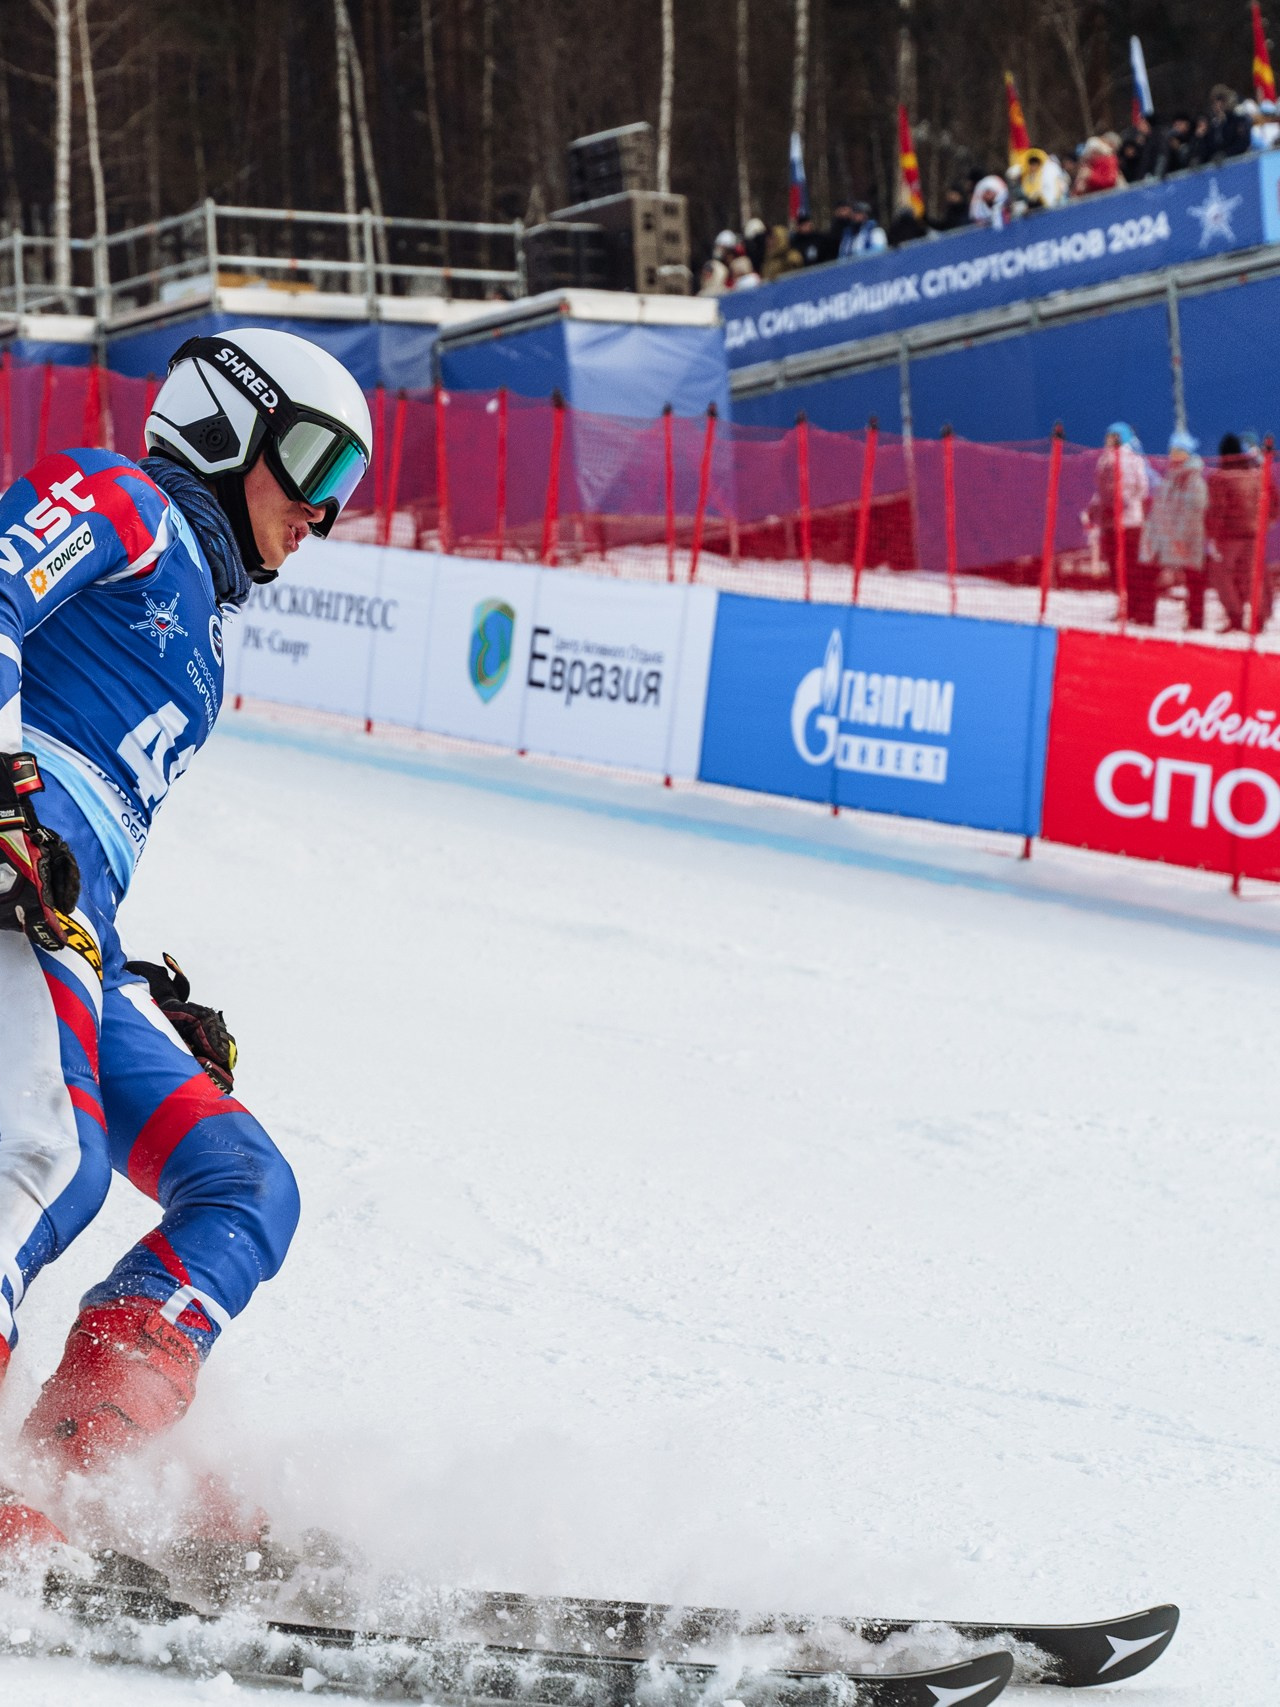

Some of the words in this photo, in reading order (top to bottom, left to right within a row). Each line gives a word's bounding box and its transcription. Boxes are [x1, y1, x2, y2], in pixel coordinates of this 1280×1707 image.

[921, 228, 1106, 298] СПОРТСМЕНОВ
[1107, 210, 1170, 254] 2024
[215, 348, 278, 408] SHRED
[528, 627, 662, 707] Евразия
[839, 669, 955, 735] ГАЗПРОМ
[1094, 749, 1280, 839] СПО
[33, 925, 59, 948] LEKI
